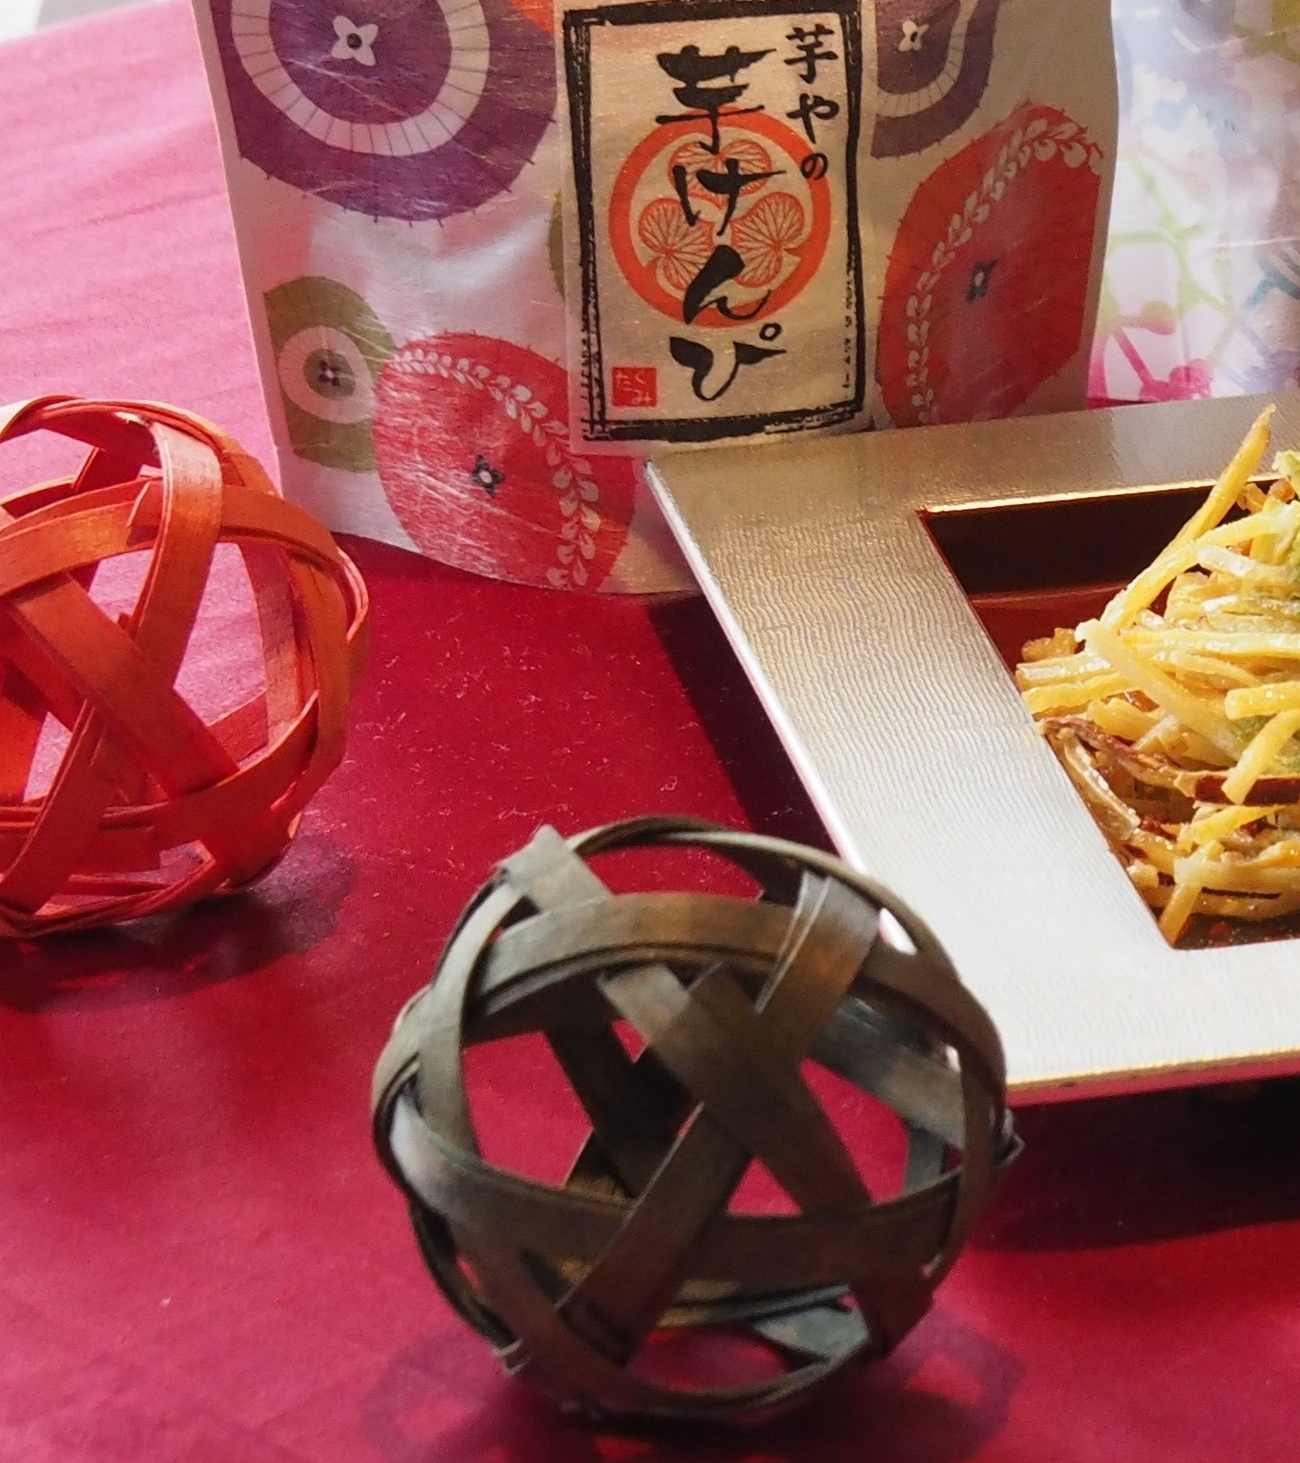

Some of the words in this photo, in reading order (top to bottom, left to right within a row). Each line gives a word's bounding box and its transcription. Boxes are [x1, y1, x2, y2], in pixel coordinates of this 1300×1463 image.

[655, 45, 788, 402] 芋けんぴ
[784, 23, 840, 181] 芋やの
